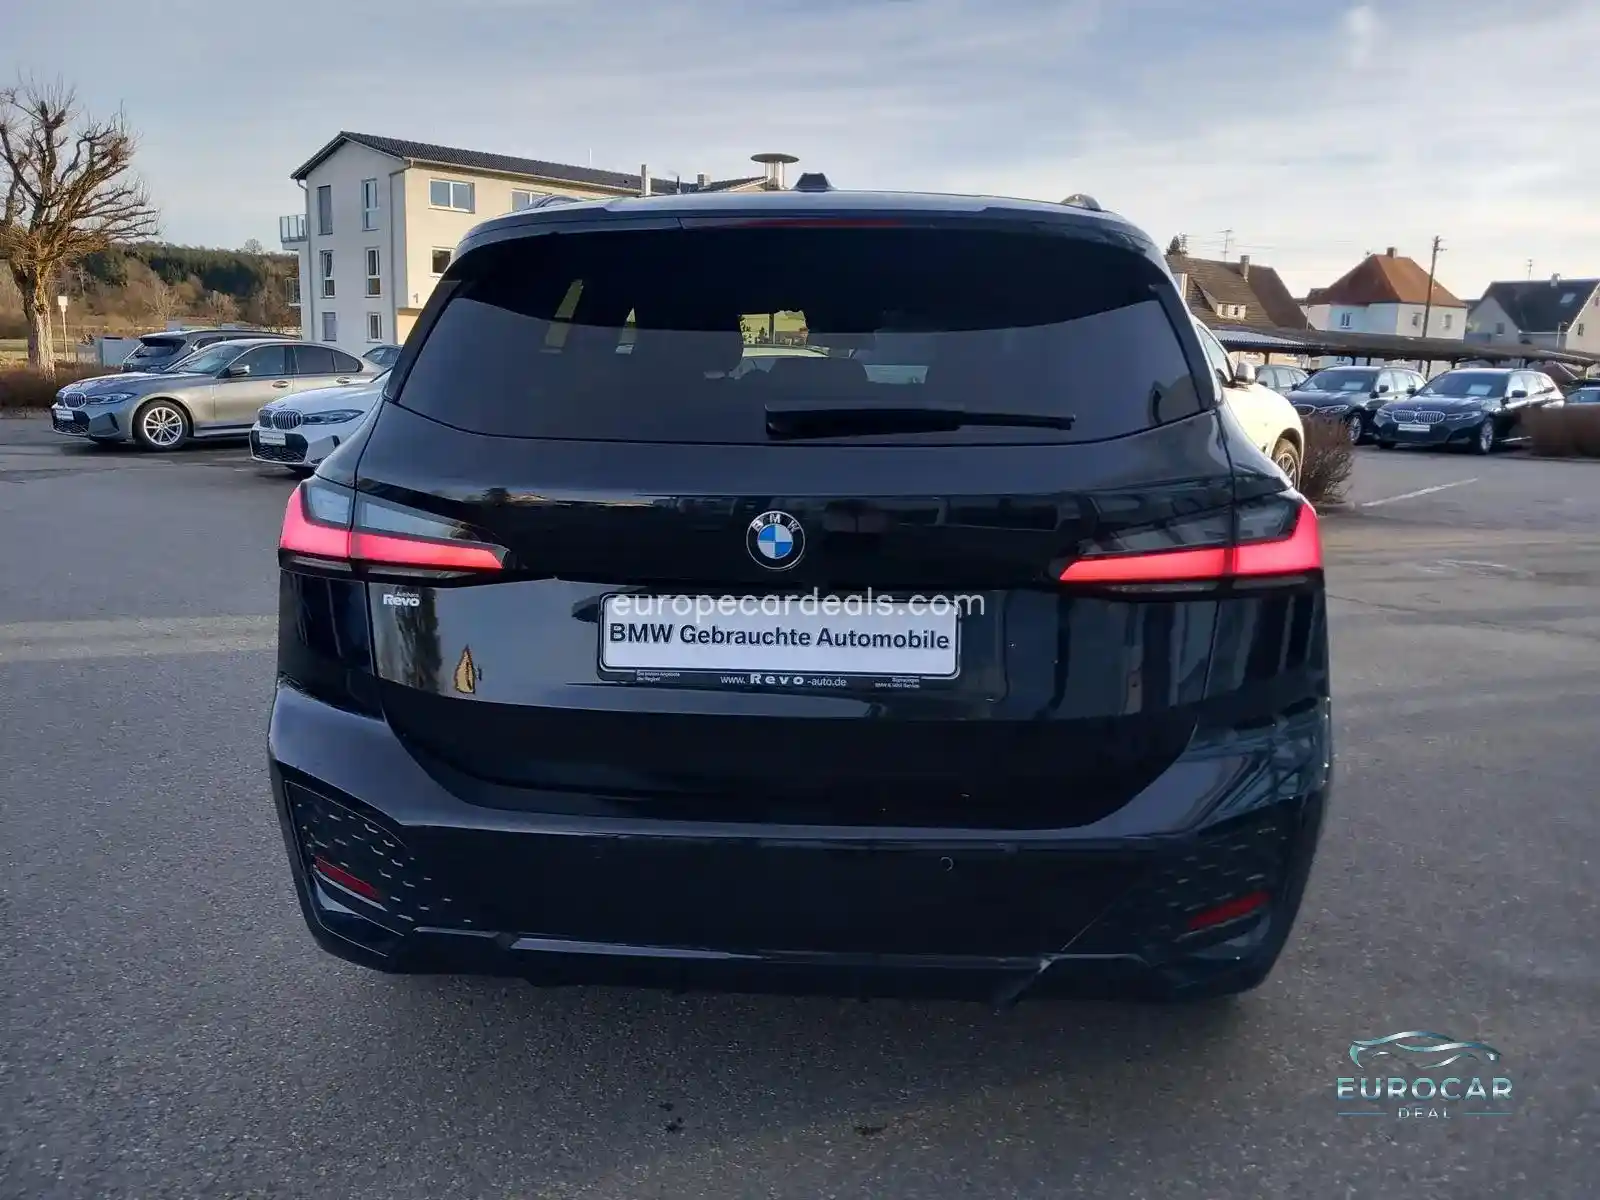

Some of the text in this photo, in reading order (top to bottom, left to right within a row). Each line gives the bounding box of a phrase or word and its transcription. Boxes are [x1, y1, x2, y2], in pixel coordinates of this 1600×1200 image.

[751, 513, 802, 533] BMW
[383, 594, 420, 606] Revo
[609, 622, 950, 649] BMW Gebrauchte Automobile
